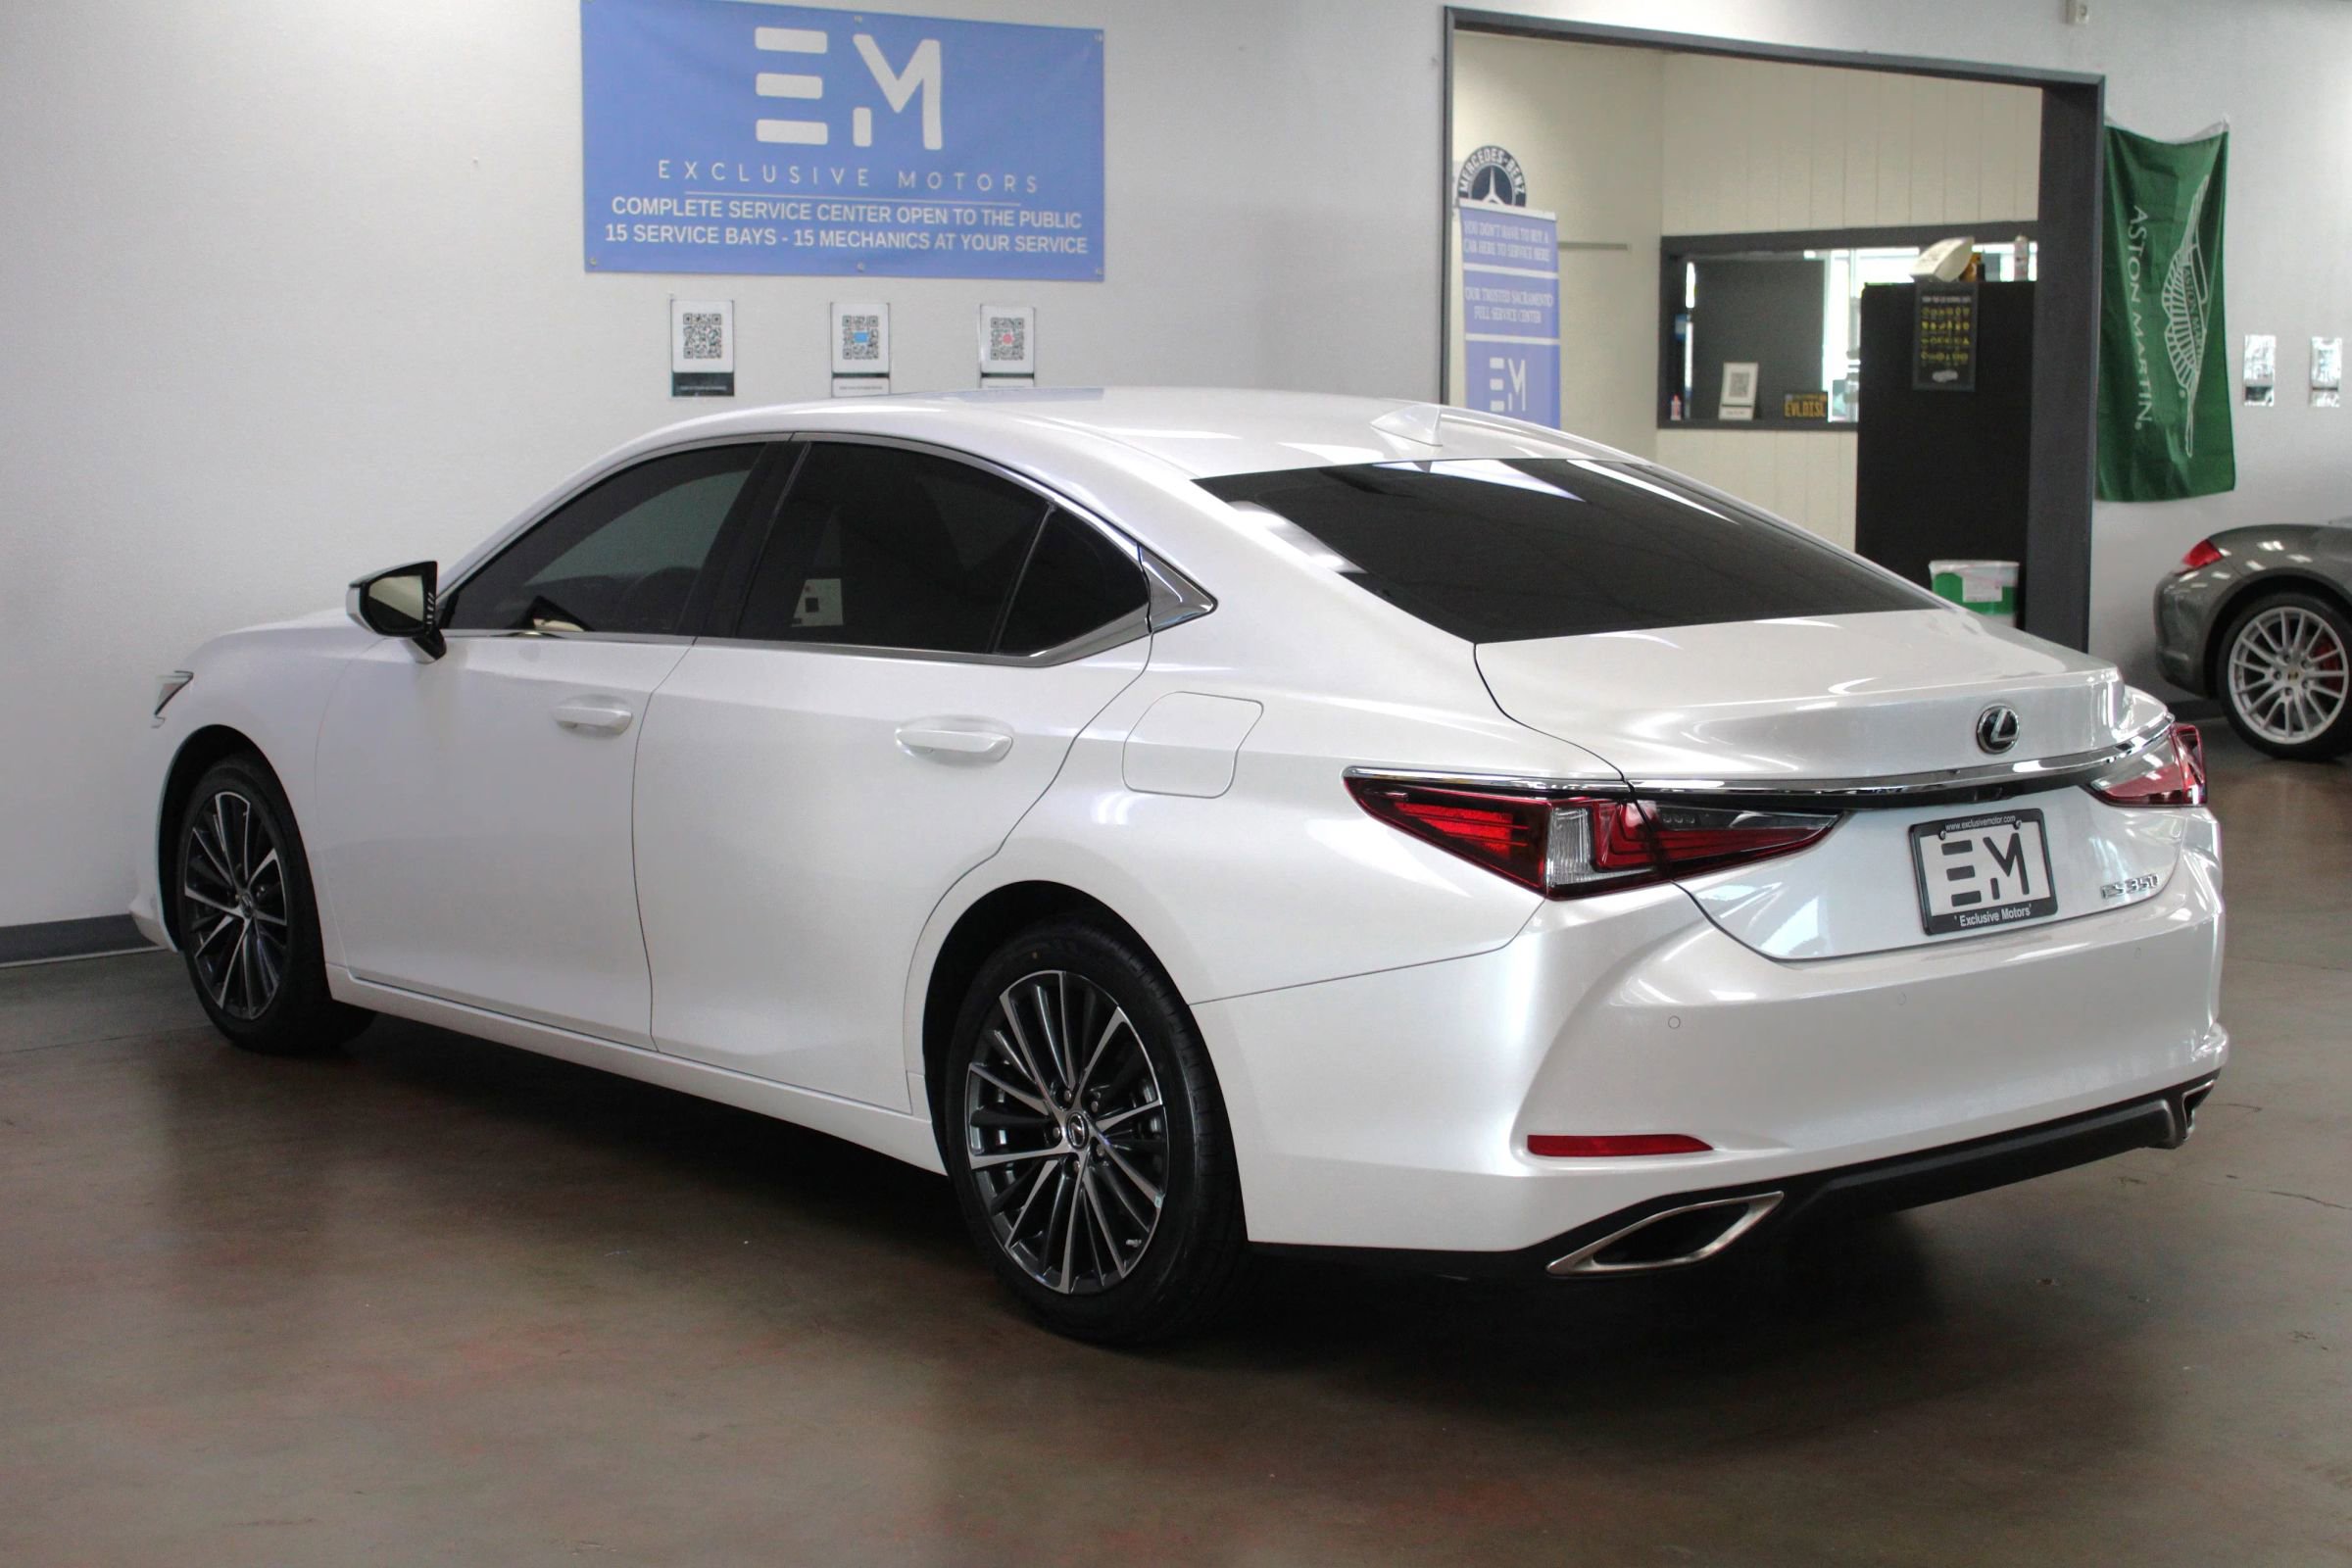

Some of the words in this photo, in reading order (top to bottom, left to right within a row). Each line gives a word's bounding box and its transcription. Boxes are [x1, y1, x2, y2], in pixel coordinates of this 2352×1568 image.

[658, 160, 869, 187] EXCLUSIVE
[898, 171, 1037, 193] MOTORS
[612, 196, 722, 218] COMPLETE
[728, 201, 811, 220] SERVICE
[816, 204, 891, 223] CENTER
[897, 207, 948, 224] OPEN
[953, 208, 976, 225] TO
[981, 209, 1015, 226] THE
[1019, 211, 1082, 228] PUBLIC
[606, 223, 627, 242] 15
[633, 224, 719, 243] SERVICE
[725, 227, 776, 245] BAYS
[794, 229, 814, 246] 15
[819, 230, 930, 250] MECHANICS
[934, 233, 956, 250] AT
[960, 234, 1010, 251] YOUR
[1014, 235, 1088, 254] SERVICE
[2128, 205, 2148, 303] ASTON
[2132, 312, 2152, 421] MARTIN
[1945, 814, 2016, 832] www.exclusivemotor.com
